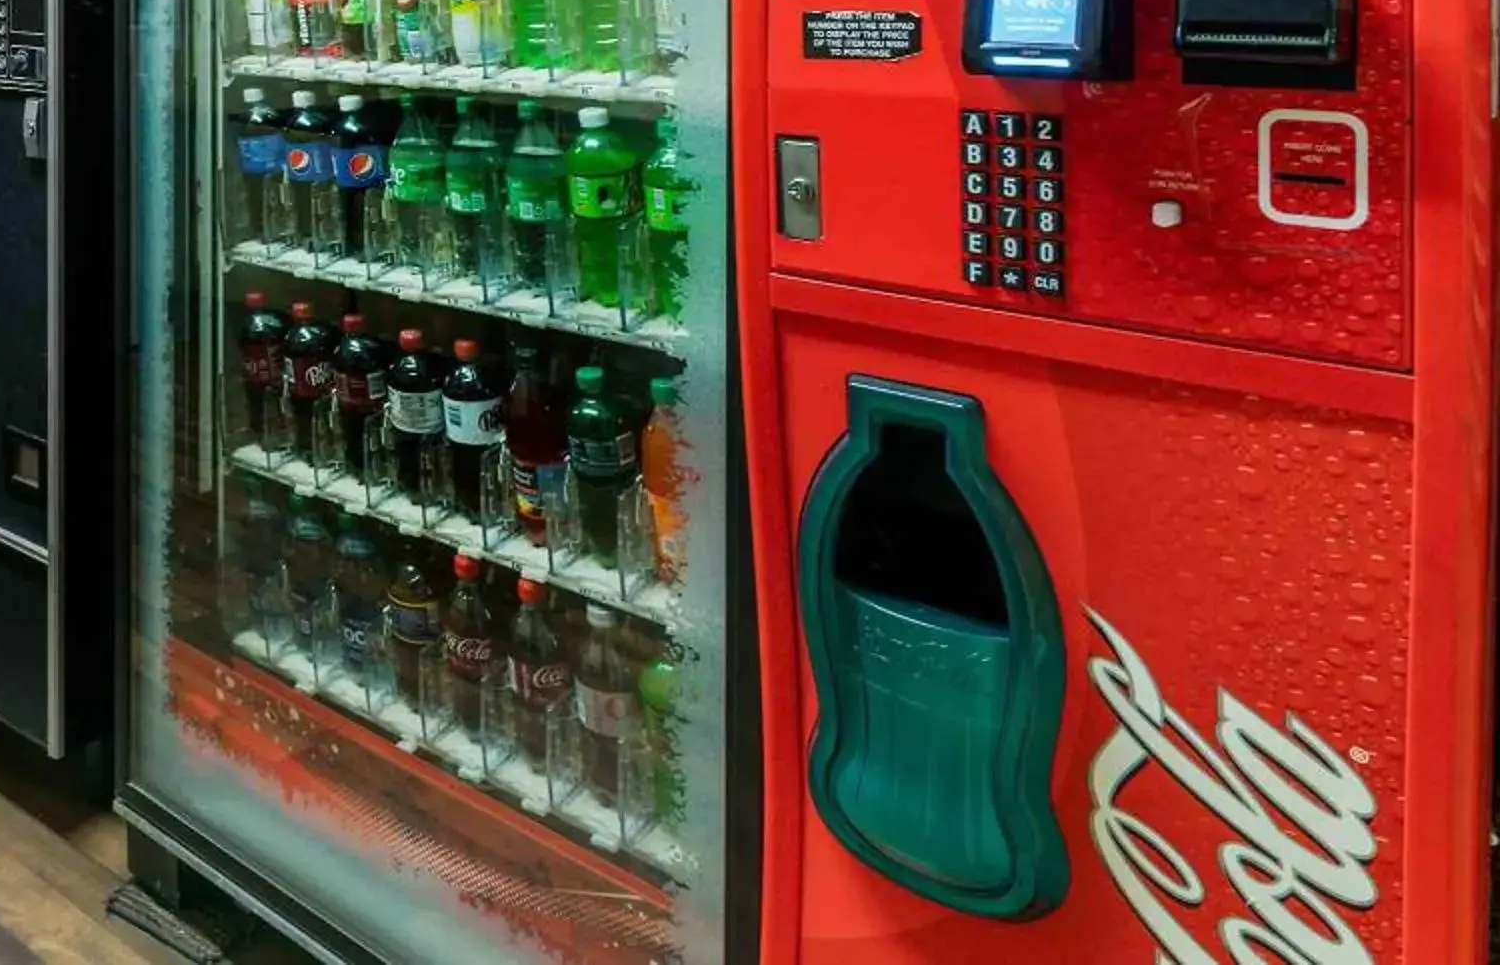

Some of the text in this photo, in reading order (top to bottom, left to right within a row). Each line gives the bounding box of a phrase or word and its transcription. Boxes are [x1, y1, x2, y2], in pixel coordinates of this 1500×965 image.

[865, 40, 885, 48] YOU
[965, 114, 983, 135] A
[1001, 118, 1013, 137] 1
[1037, 120, 1052, 140] 2
[966, 144, 981, 164] B
[1002, 147, 1016, 167] 3
[1038, 150, 1054, 170] 4
[967, 174, 982, 194] C
[1003, 177, 1017, 198] 5
[1039, 181, 1054, 201] 6
[967, 203, 982, 224] D
[1003, 208, 1017, 228] 7
[1039, 212, 1054, 232] 8
[968, 234, 982, 254] E
[1003, 237, 1017, 258] 9
[1040, 242, 1054, 262] 0
[969, 263, 983, 282] F
[1033, 276, 1059, 291] CLR
